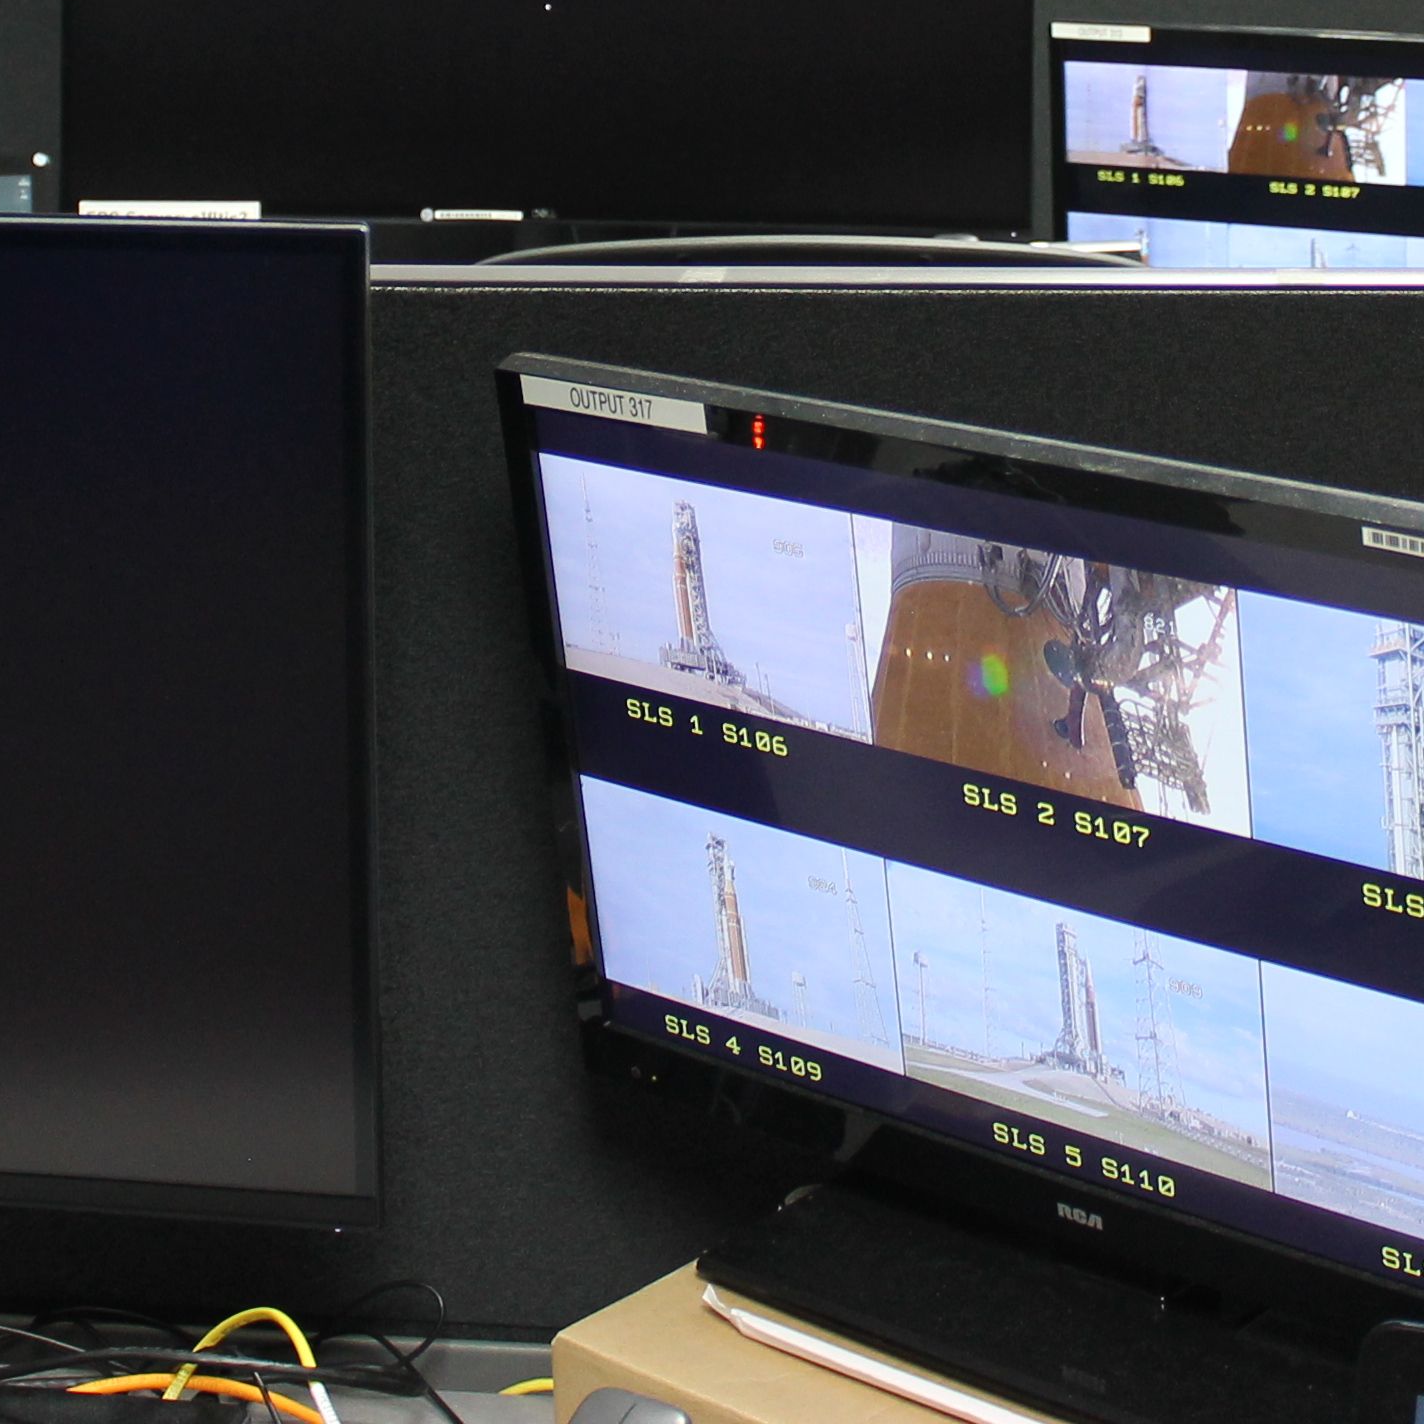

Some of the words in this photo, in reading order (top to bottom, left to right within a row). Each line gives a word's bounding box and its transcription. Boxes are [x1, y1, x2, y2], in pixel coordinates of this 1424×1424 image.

[1097, 170, 1124, 183] SLS
[1269, 181, 1297, 195] SLS
[1305, 184, 1315, 196] 2
[1322, 184, 1360, 198] S107
[570, 387, 624, 415] OUTPUT
[629, 396, 652, 420] 317
[1144, 616, 1175, 636] 821
[626, 698, 673, 731] SLS
[689, 713, 703, 736] 1
[722, 722, 788, 758] S106
[962, 783, 1017, 817] SLS
[1037, 802, 1055, 826] 2
[1075, 812, 1151, 849] S107
[1362, 883, 1424, 919] SLS
[663, 1014, 711, 1047] SLS
[725, 1034, 741, 1056] 4
[758, 1045, 824, 1082] S109
[992, 1121, 1046, 1156] SLS
[1065, 1144, 1082, 1168] 5
[1102, 1155, 1177, 1198] S110
[1057, 1202, 1103, 1230] RCA
